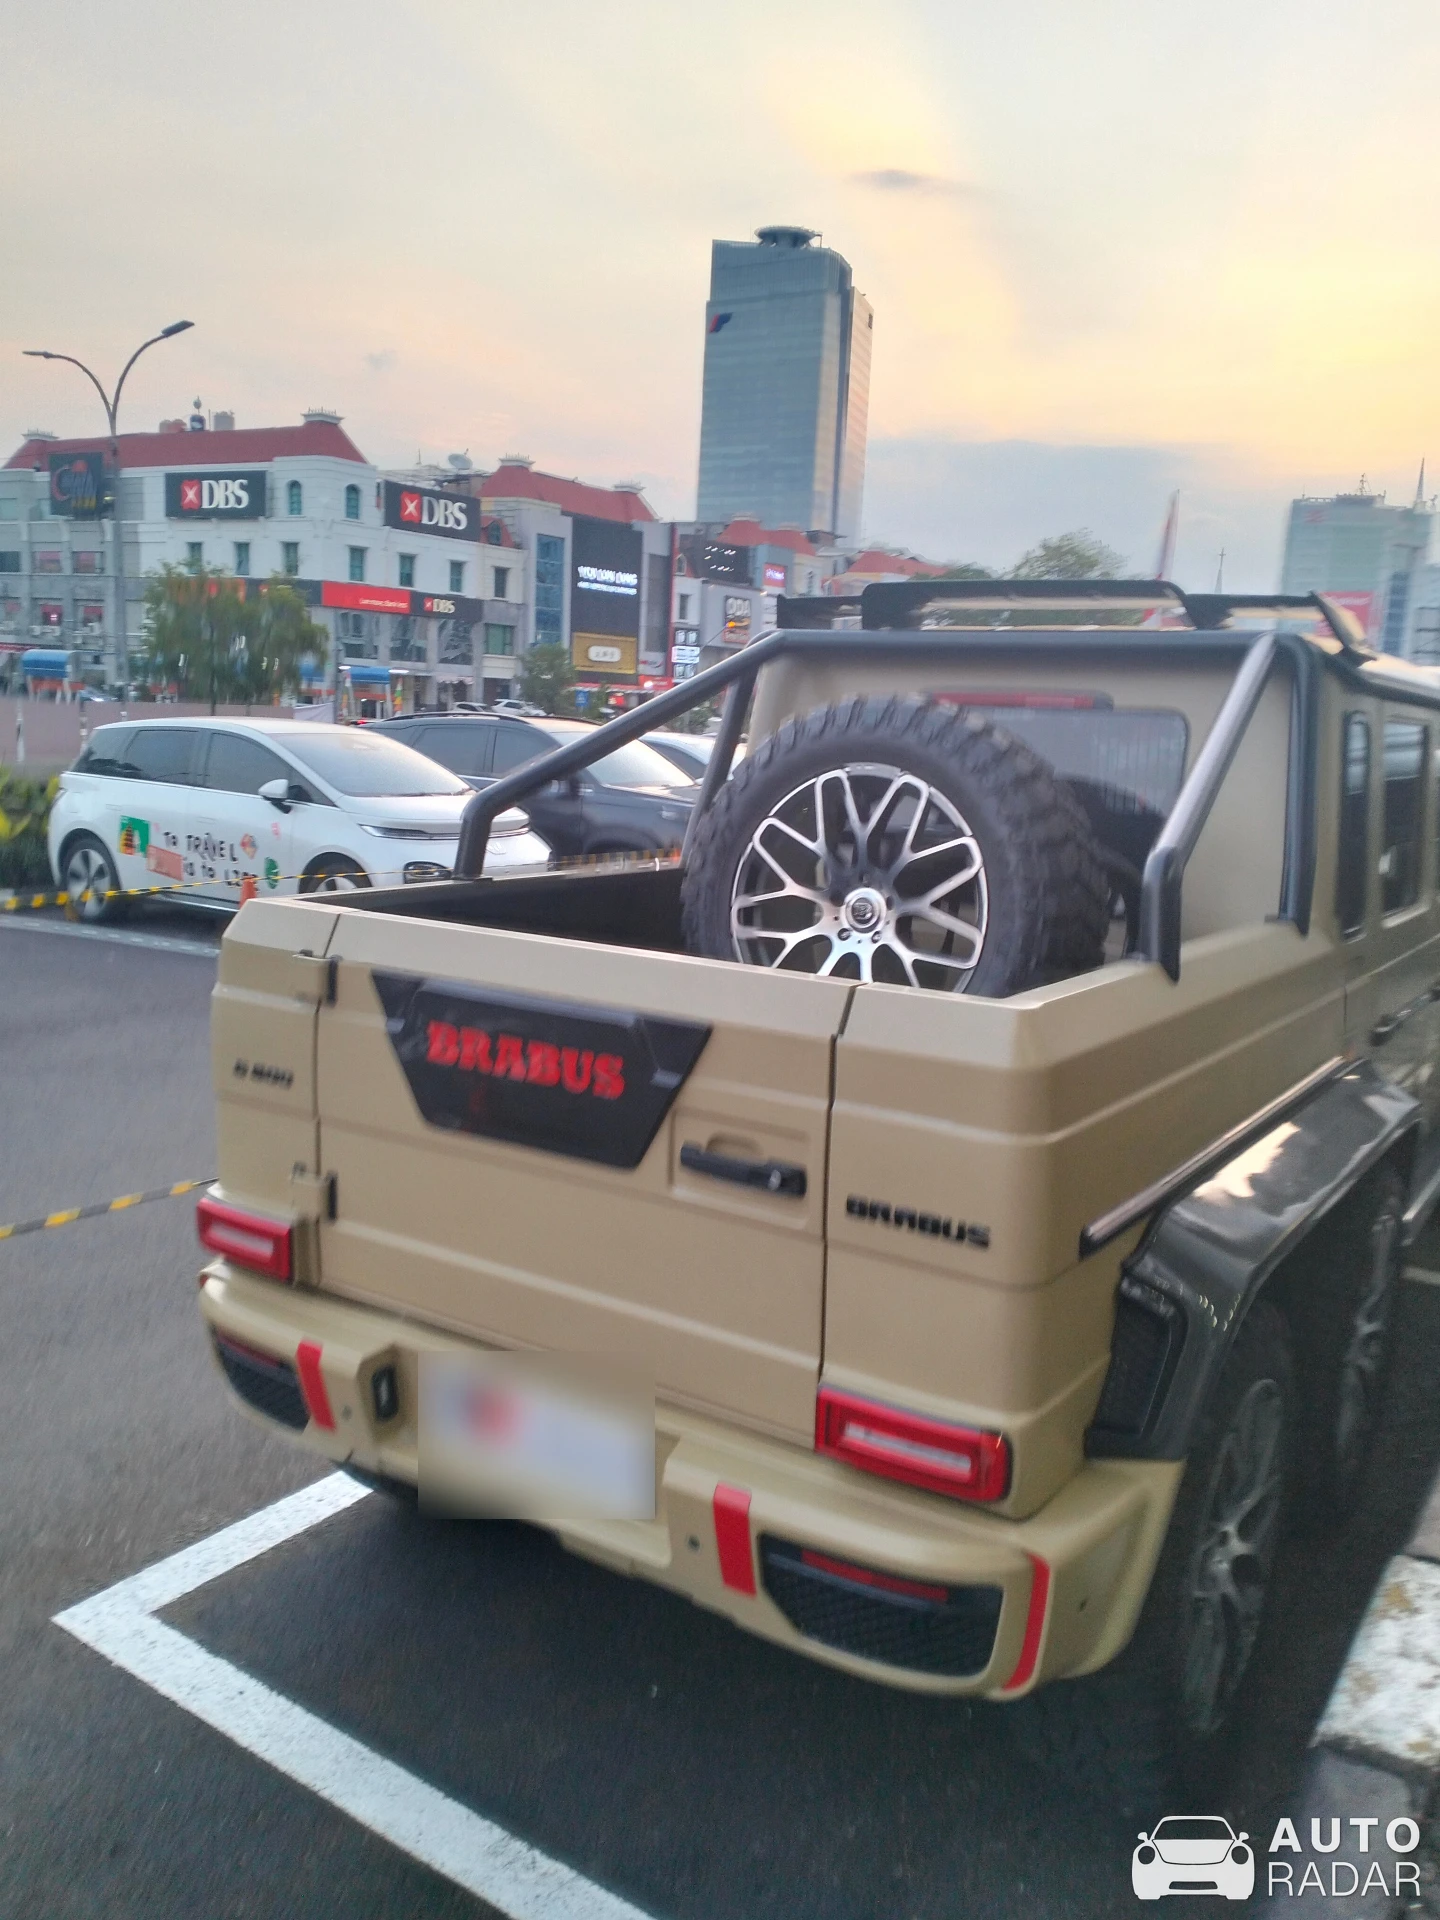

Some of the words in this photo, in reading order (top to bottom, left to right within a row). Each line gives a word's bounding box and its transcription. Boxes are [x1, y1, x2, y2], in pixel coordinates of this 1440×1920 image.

[201, 479, 249, 508] DBS
[421, 496, 467, 530] DBS
[427, 1019, 626, 1099] BRABUS
[846, 1194, 991, 1250] BRABUS
